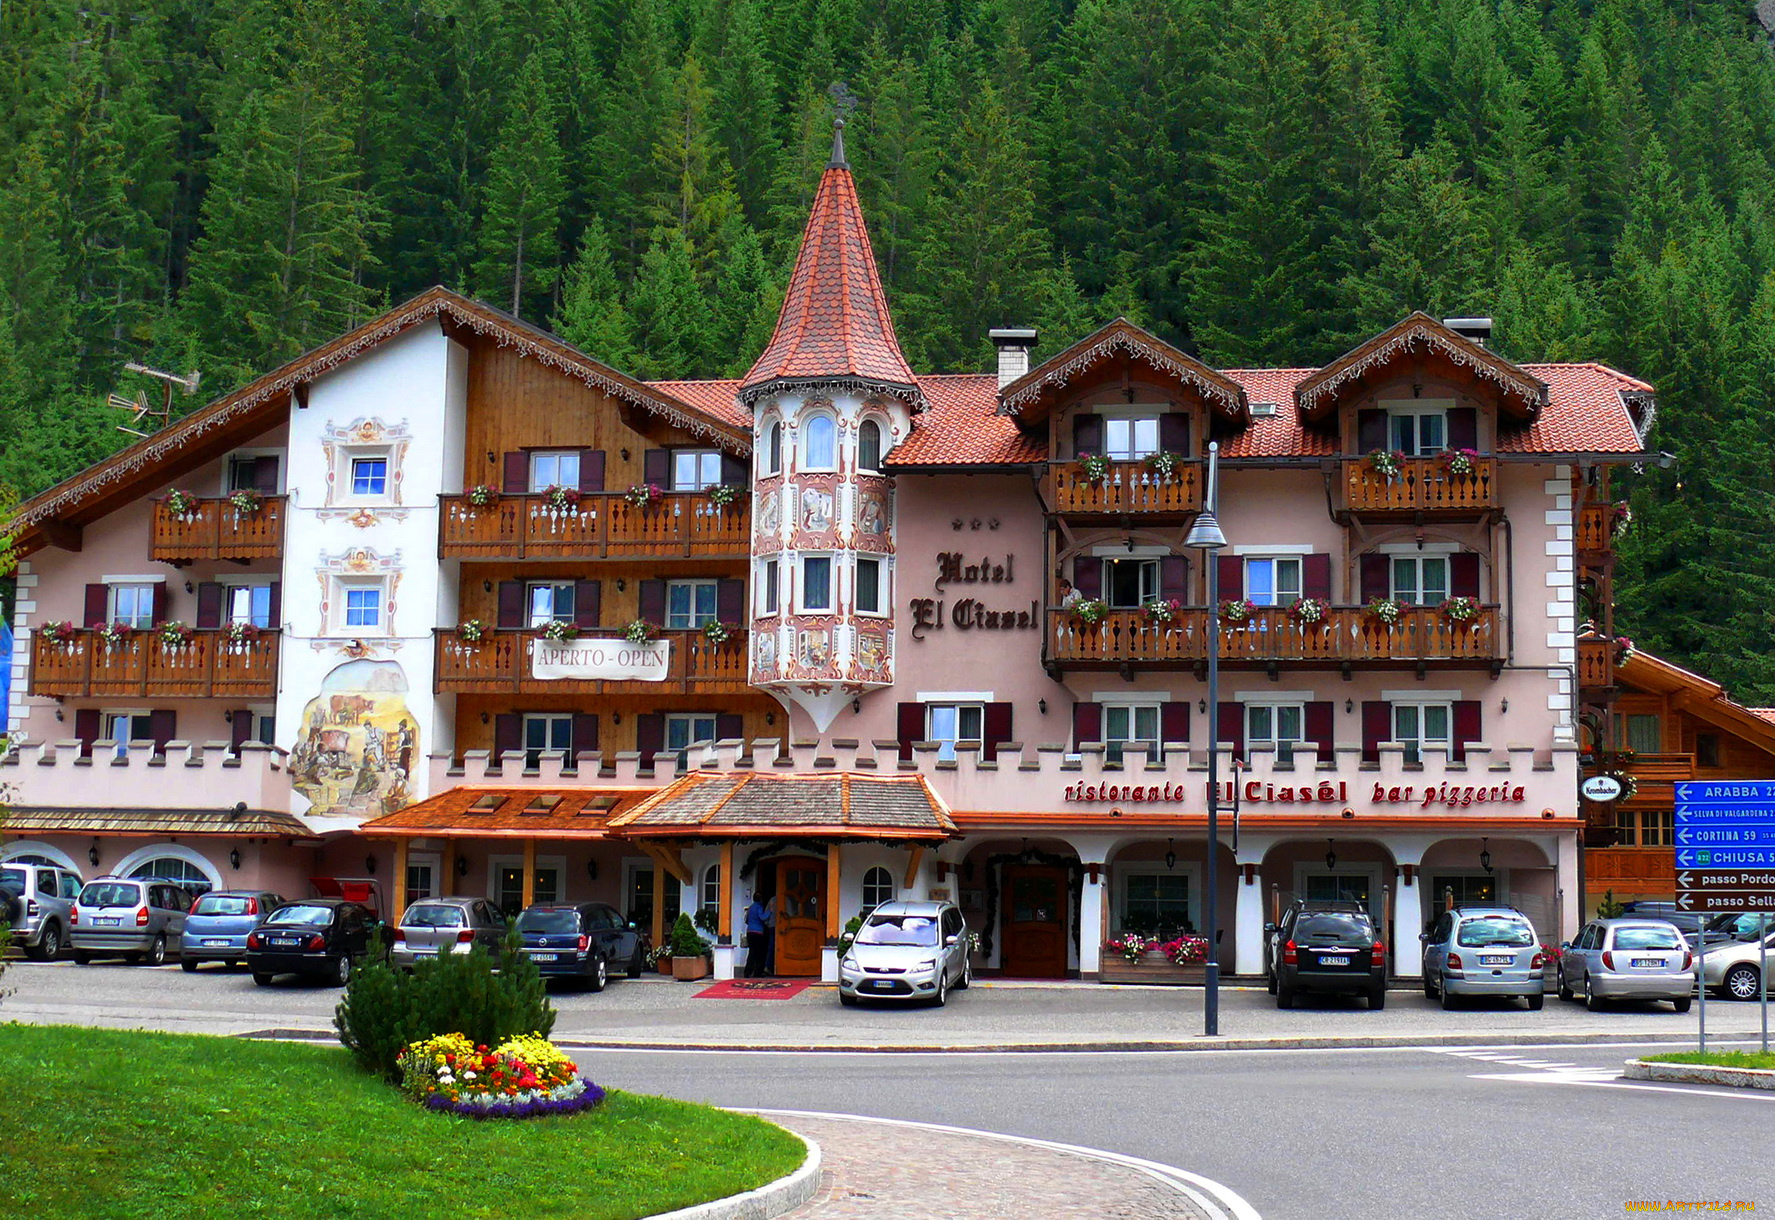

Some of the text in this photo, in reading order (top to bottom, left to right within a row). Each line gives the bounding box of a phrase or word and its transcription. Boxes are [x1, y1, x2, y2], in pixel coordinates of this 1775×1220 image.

[935, 552, 1014, 592] Hotel
[909, 598, 1039, 640] El Ciasel
[537, 649, 605, 666] APERTO
[617, 649, 666, 667] OPEN
[1064, 780, 1184, 801] ristorante
[1245, 780, 1347, 802] Ciasél
[1371, 781, 1413, 802] bar
[1421, 780, 1525, 807] pizzeria
[1705, 786, 1759, 797] ARABBA
[1724, 809, 1768, 817] VALGARDENA
[1696, 831, 1739, 841] CORTINA
[1743, 830, 1756, 841] 59
[1713, 852, 1765, 863] CHIUSA
[1702, 874, 1775, 886] passo Pordo
[1707, 895, 1775, 908] passo Sell
